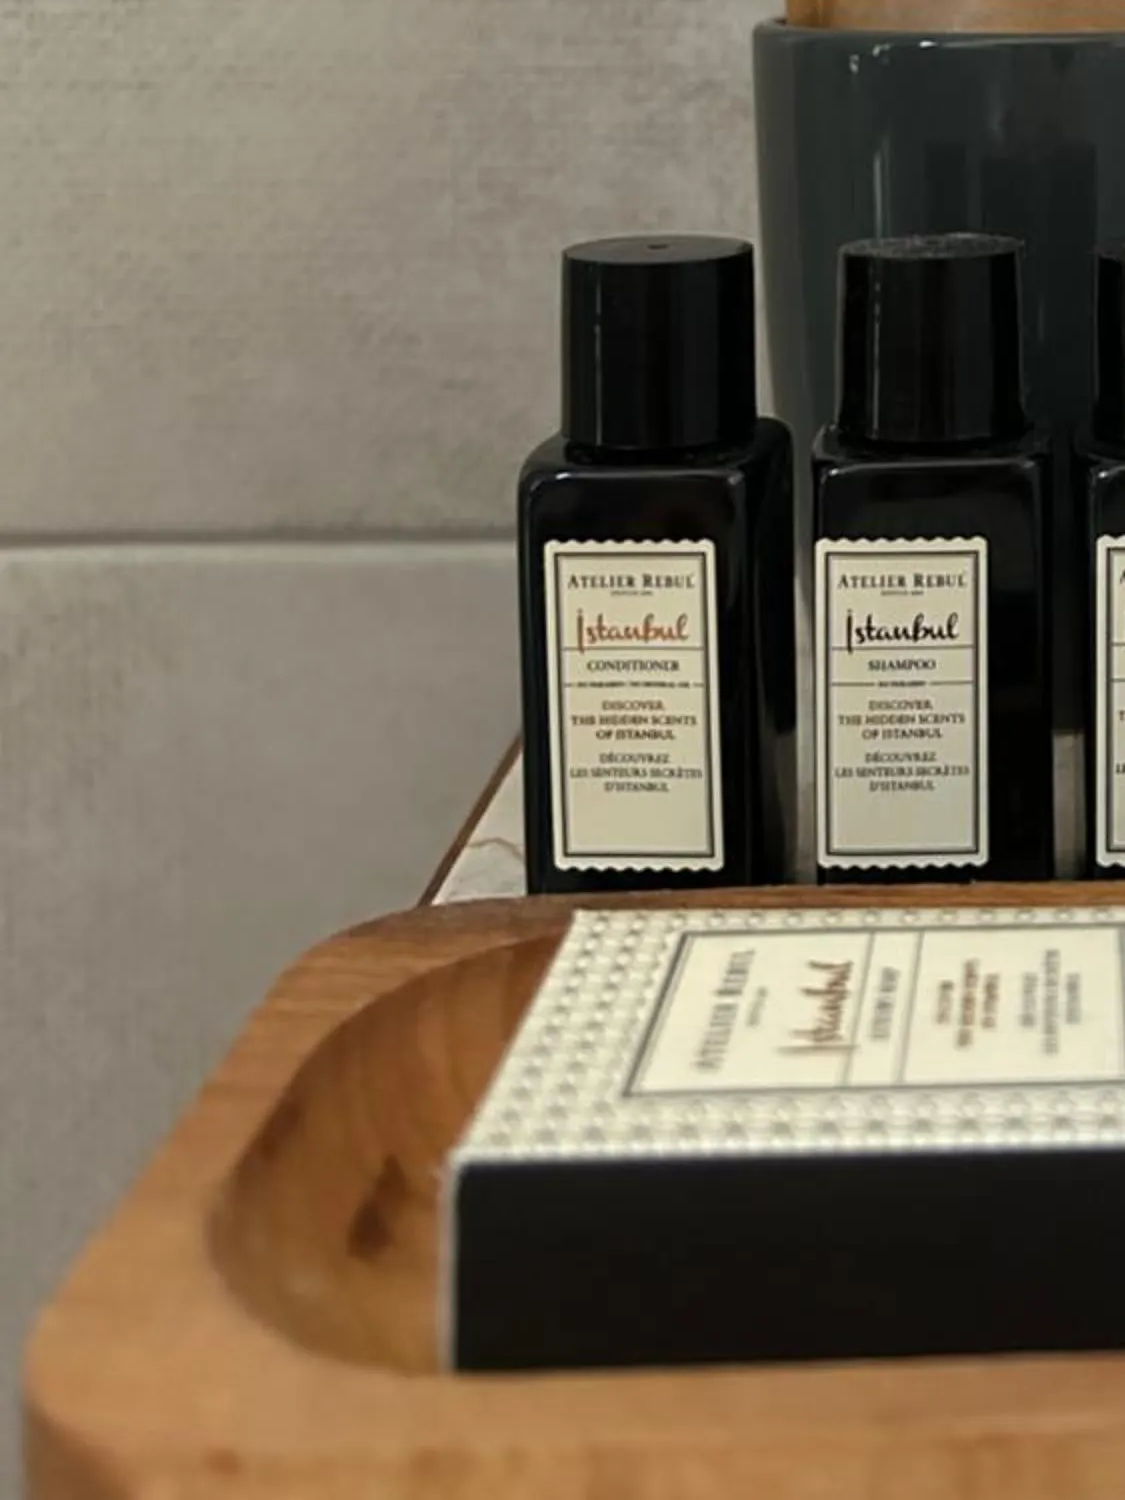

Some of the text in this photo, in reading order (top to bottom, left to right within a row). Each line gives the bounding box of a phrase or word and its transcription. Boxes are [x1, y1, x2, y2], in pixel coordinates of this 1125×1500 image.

[567, 572, 694, 589] ATELIER REBUL
[838, 573, 966, 589] ATELIER REBUL
[586, 660, 679, 672] CONDITIONER
[868, 659, 936, 671] SHAMPOO
[602, 700, 664, 710] DISCOVER
[868, 700, 932, 710] DISCOVER
[572, 715, 697, 726] THE HIDDEN SCENTS
[838, 714, 965, 726] THE HIDDEN SCENTS
[596, 730, 675, 740] OF ISTANBUL
[862, 729, 942, 740] OF ISTANBUL
[695, 1003, 739, 1071] ATELIER
